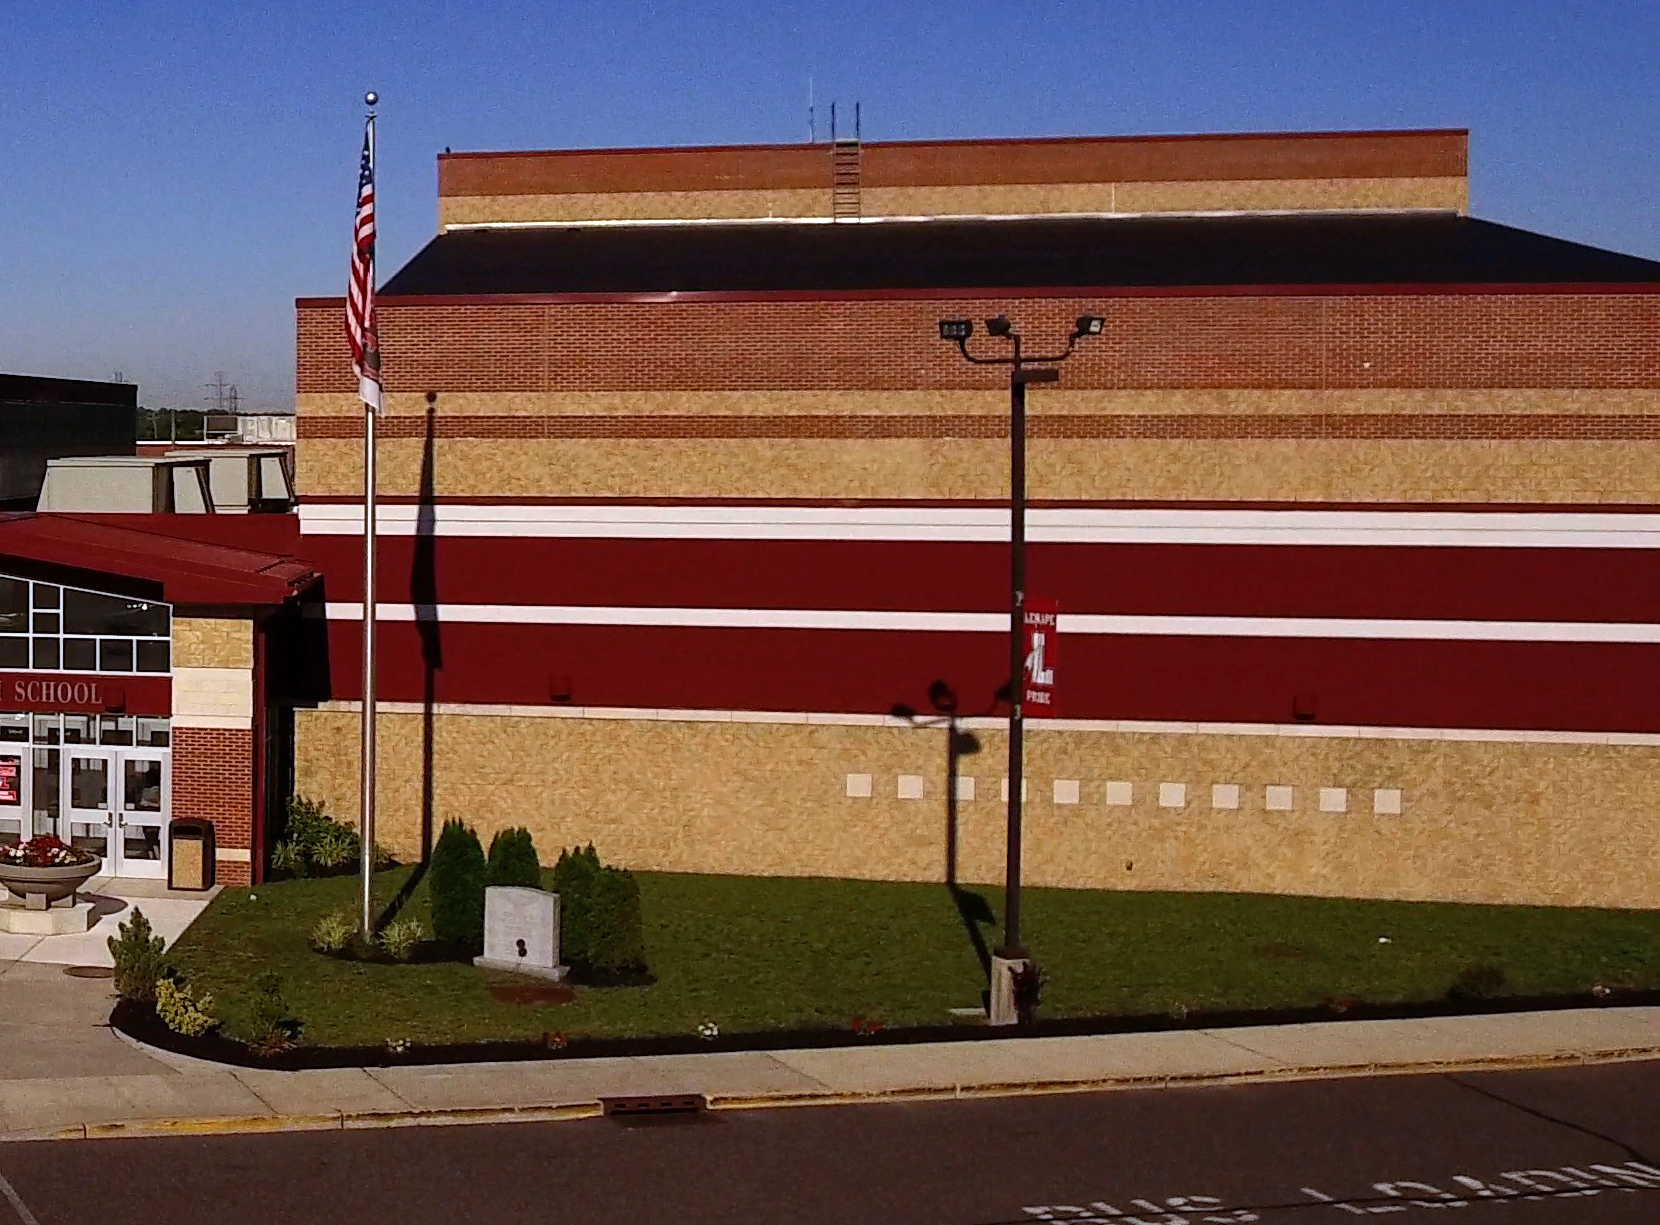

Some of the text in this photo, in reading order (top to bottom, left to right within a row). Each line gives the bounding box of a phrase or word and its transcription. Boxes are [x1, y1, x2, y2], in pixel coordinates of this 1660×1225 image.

[1024, 613, 1054, 626] LENAPE
[14, 680, 103, 705] SCHOOL
[1026, 690, 1050, 704] PRIDE
[1022, 1194, 1262, 1225] BUS
